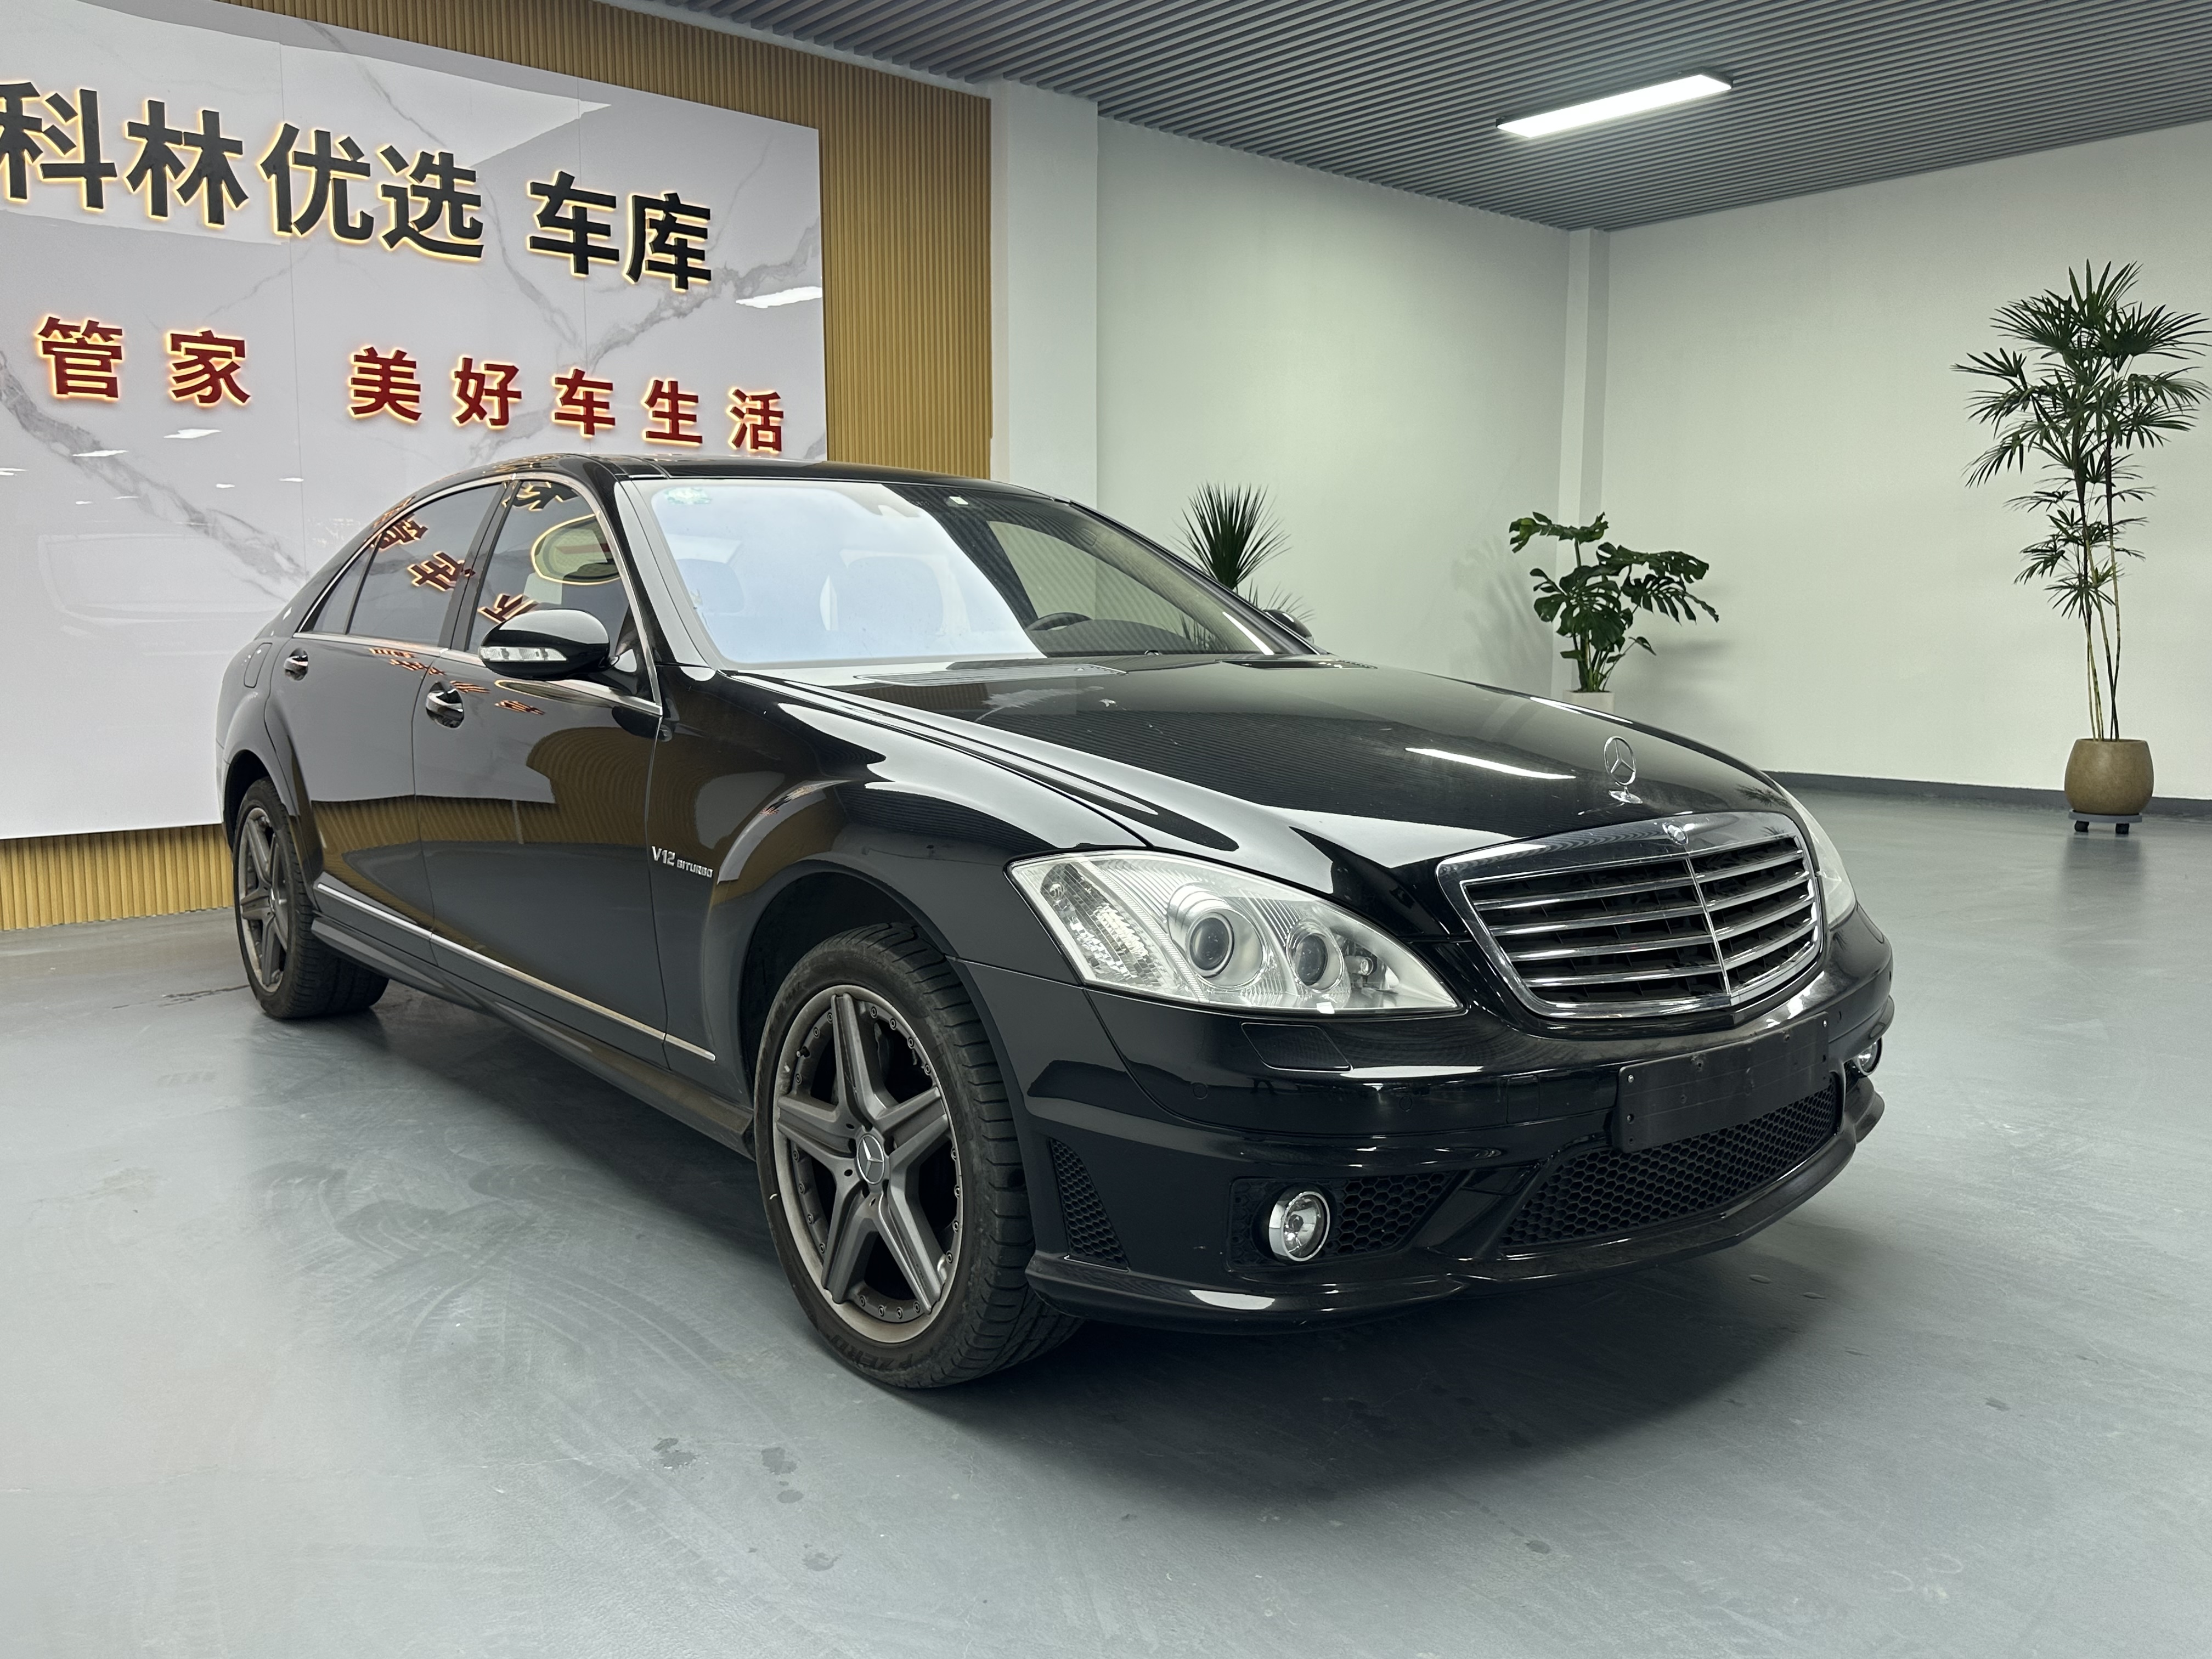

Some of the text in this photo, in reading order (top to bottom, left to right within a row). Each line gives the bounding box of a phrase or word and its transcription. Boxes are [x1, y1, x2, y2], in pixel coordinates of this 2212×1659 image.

[0, 82, 712, 291] 科林优选 车库
[38, 317, 785, 453] 管家 美好车生活
[651, 845, 714, 878] V12 BITURBO
